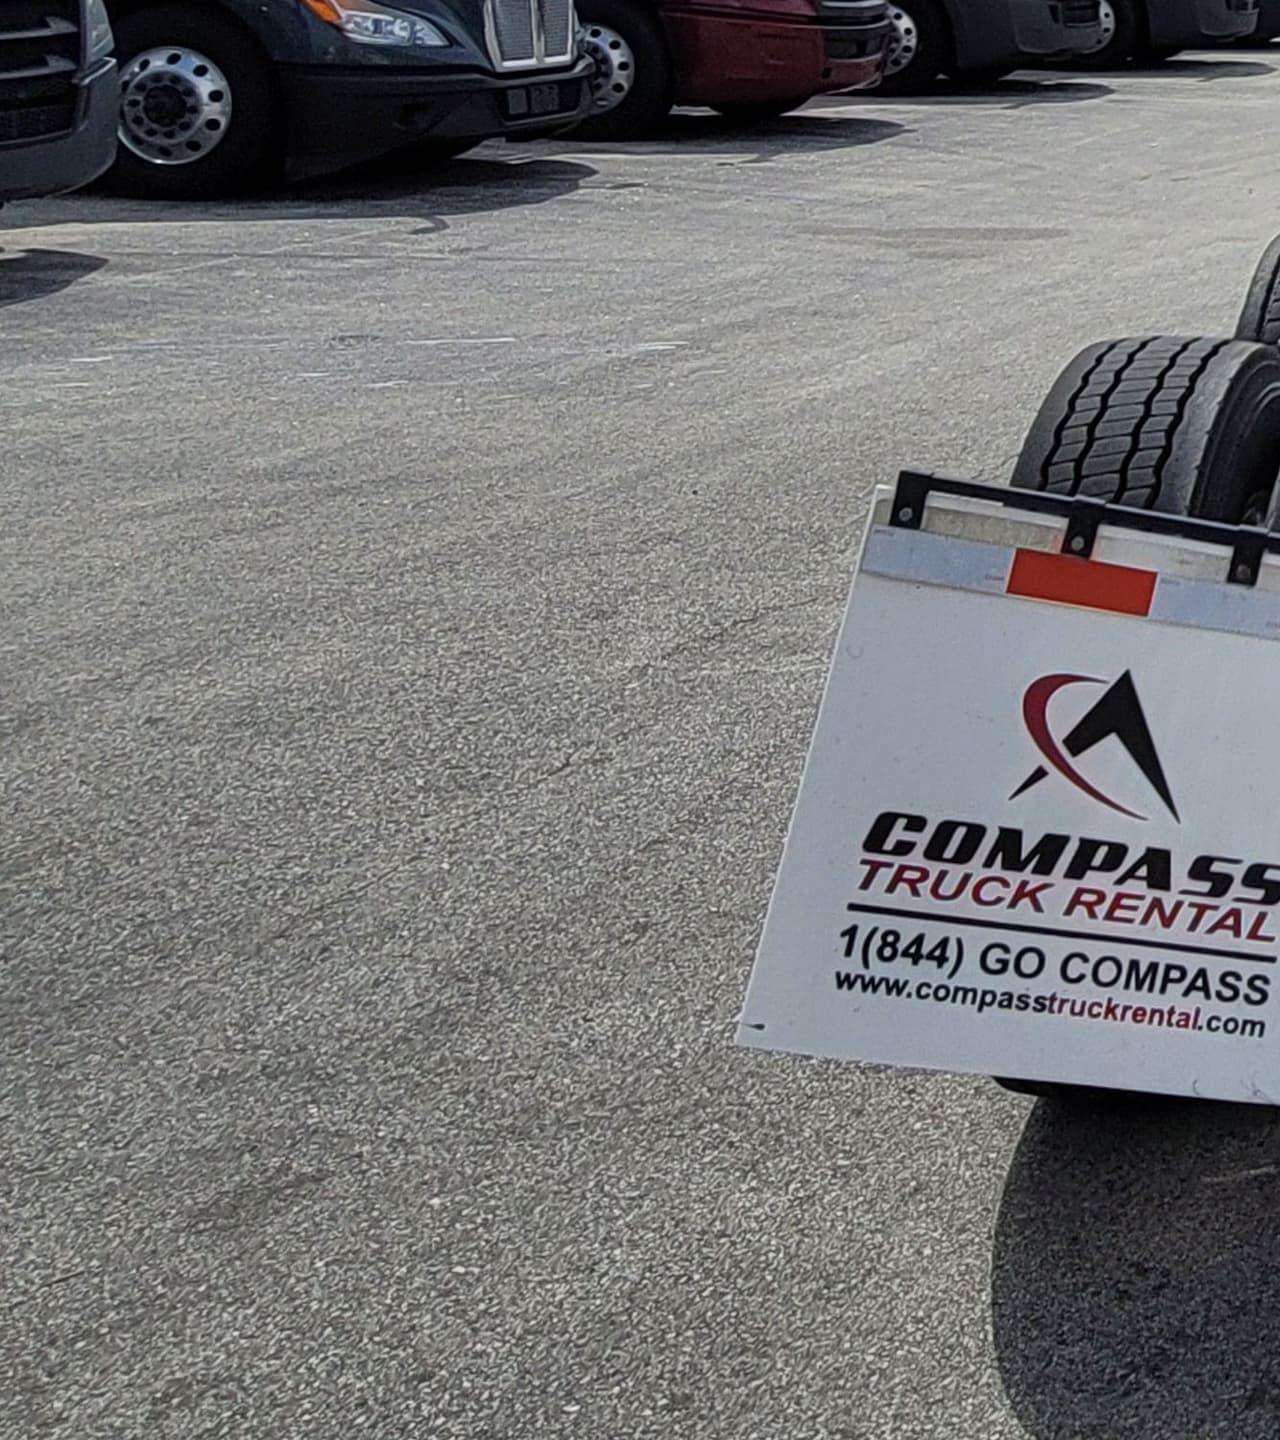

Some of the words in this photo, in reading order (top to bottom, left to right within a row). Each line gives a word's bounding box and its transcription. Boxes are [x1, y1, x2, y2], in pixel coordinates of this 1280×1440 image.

[858, 859, 1055, 913] TRUCK
[1063, 886, 1277, 942] RENTAL
[834, 971, 1267, 1038] www.compasstruckrental.com
[838, 924, 965, 978] 1(844)
[979, 942, 1046, 980] GO
[1060, 951, 1271, 1006] COMPASS
